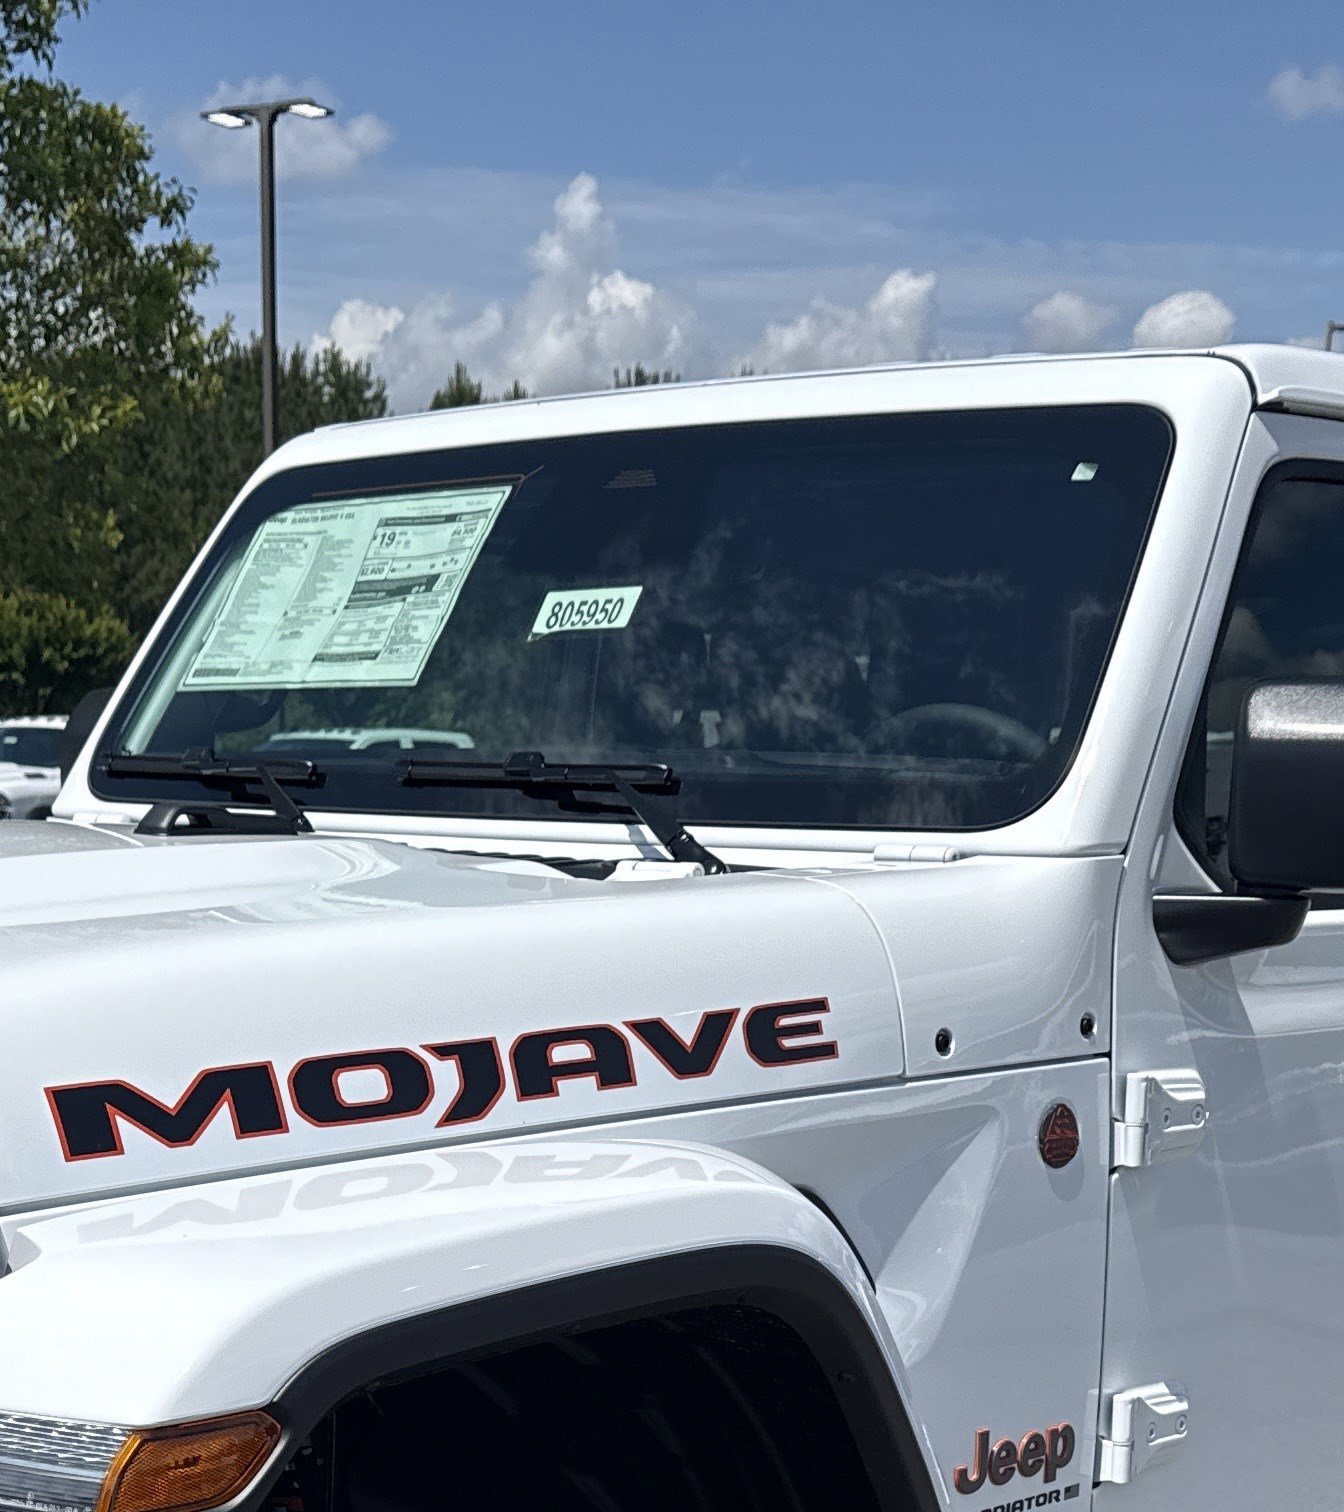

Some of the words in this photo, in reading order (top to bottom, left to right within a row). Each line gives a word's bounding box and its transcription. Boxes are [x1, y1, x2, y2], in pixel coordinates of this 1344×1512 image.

[379, 531, 397, 548] 19
[545, 597, 625, 629] 805950
[44, 997, 839, 1162] MOJAVE
[953, 1422, 1075, 1495] Jeep
